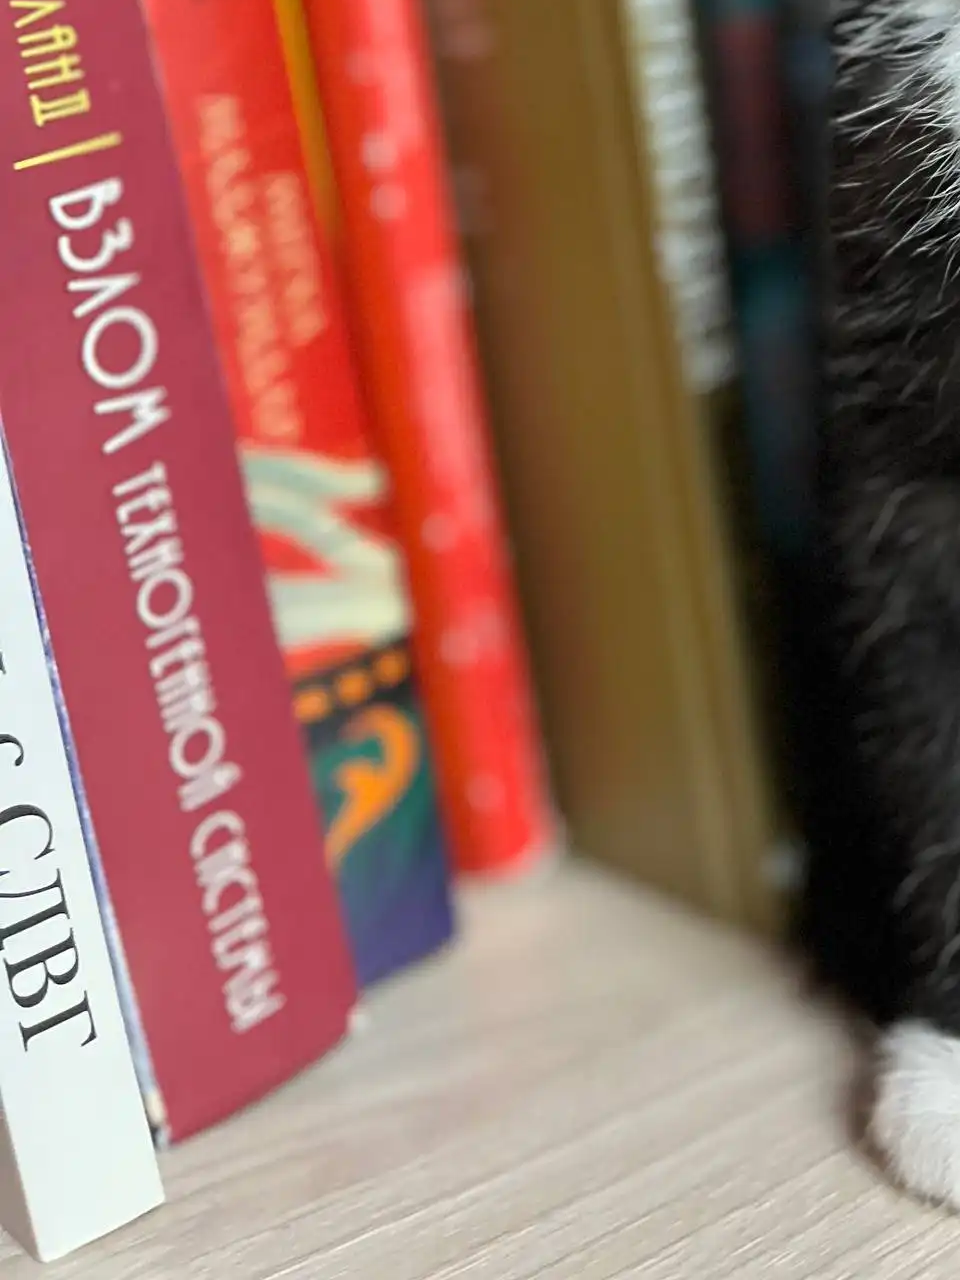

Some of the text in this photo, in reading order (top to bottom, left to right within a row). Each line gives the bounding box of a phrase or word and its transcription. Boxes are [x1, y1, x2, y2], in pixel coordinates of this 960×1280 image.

[49, 176, 288, 1034] ВЗЛОМ ТЕХНОГЕННОЙ СИСТЕМЫ
[0, 804, 97, 1052] СДВГ
